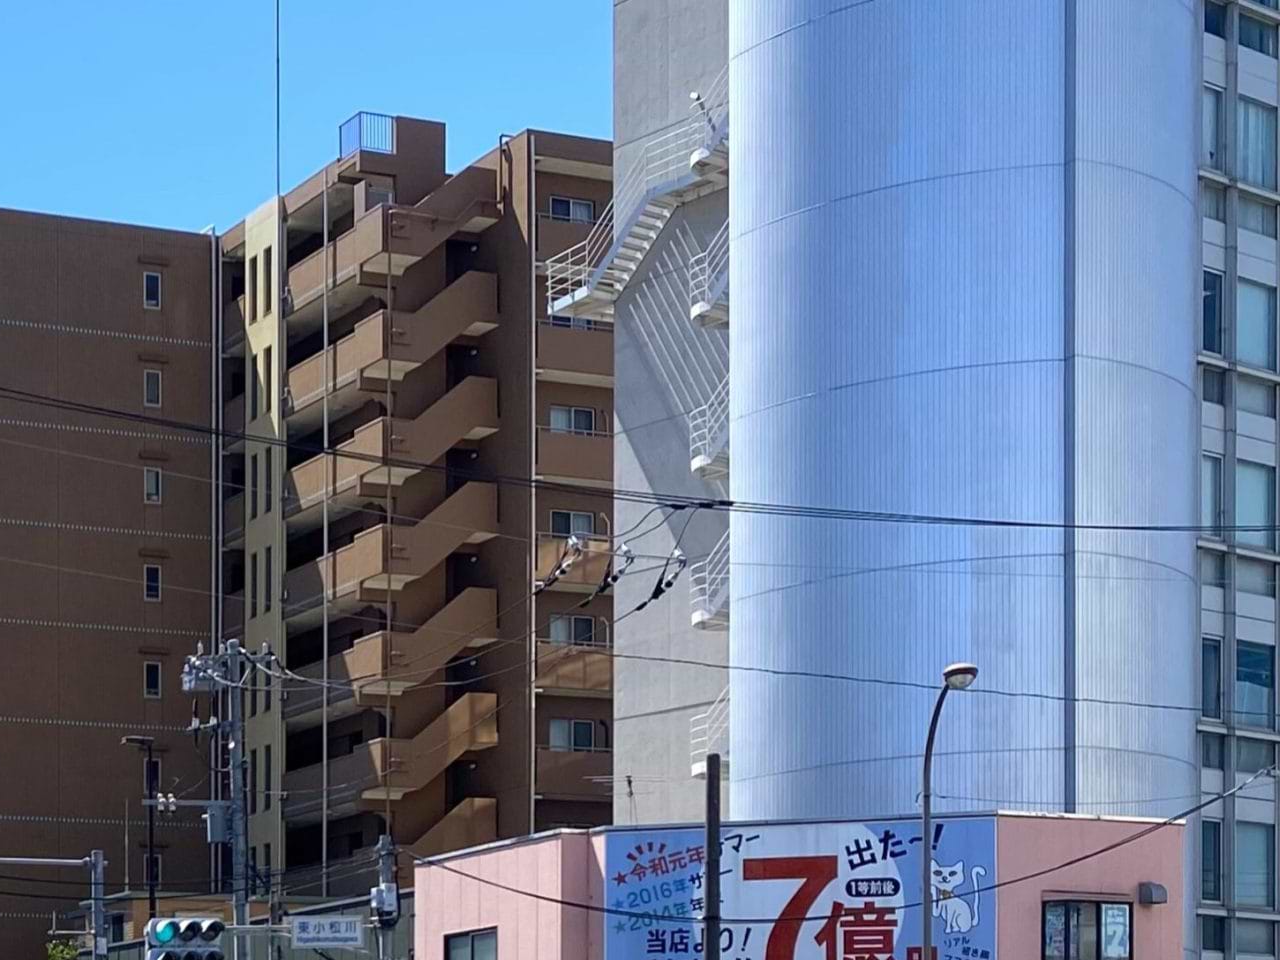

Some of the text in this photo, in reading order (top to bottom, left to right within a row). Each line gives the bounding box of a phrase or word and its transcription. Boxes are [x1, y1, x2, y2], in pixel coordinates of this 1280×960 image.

[849, 880, 895, 897] 1等前後
[298, 921, 357, 934] 東小松川
[944, 936, 970, 948] リアル
